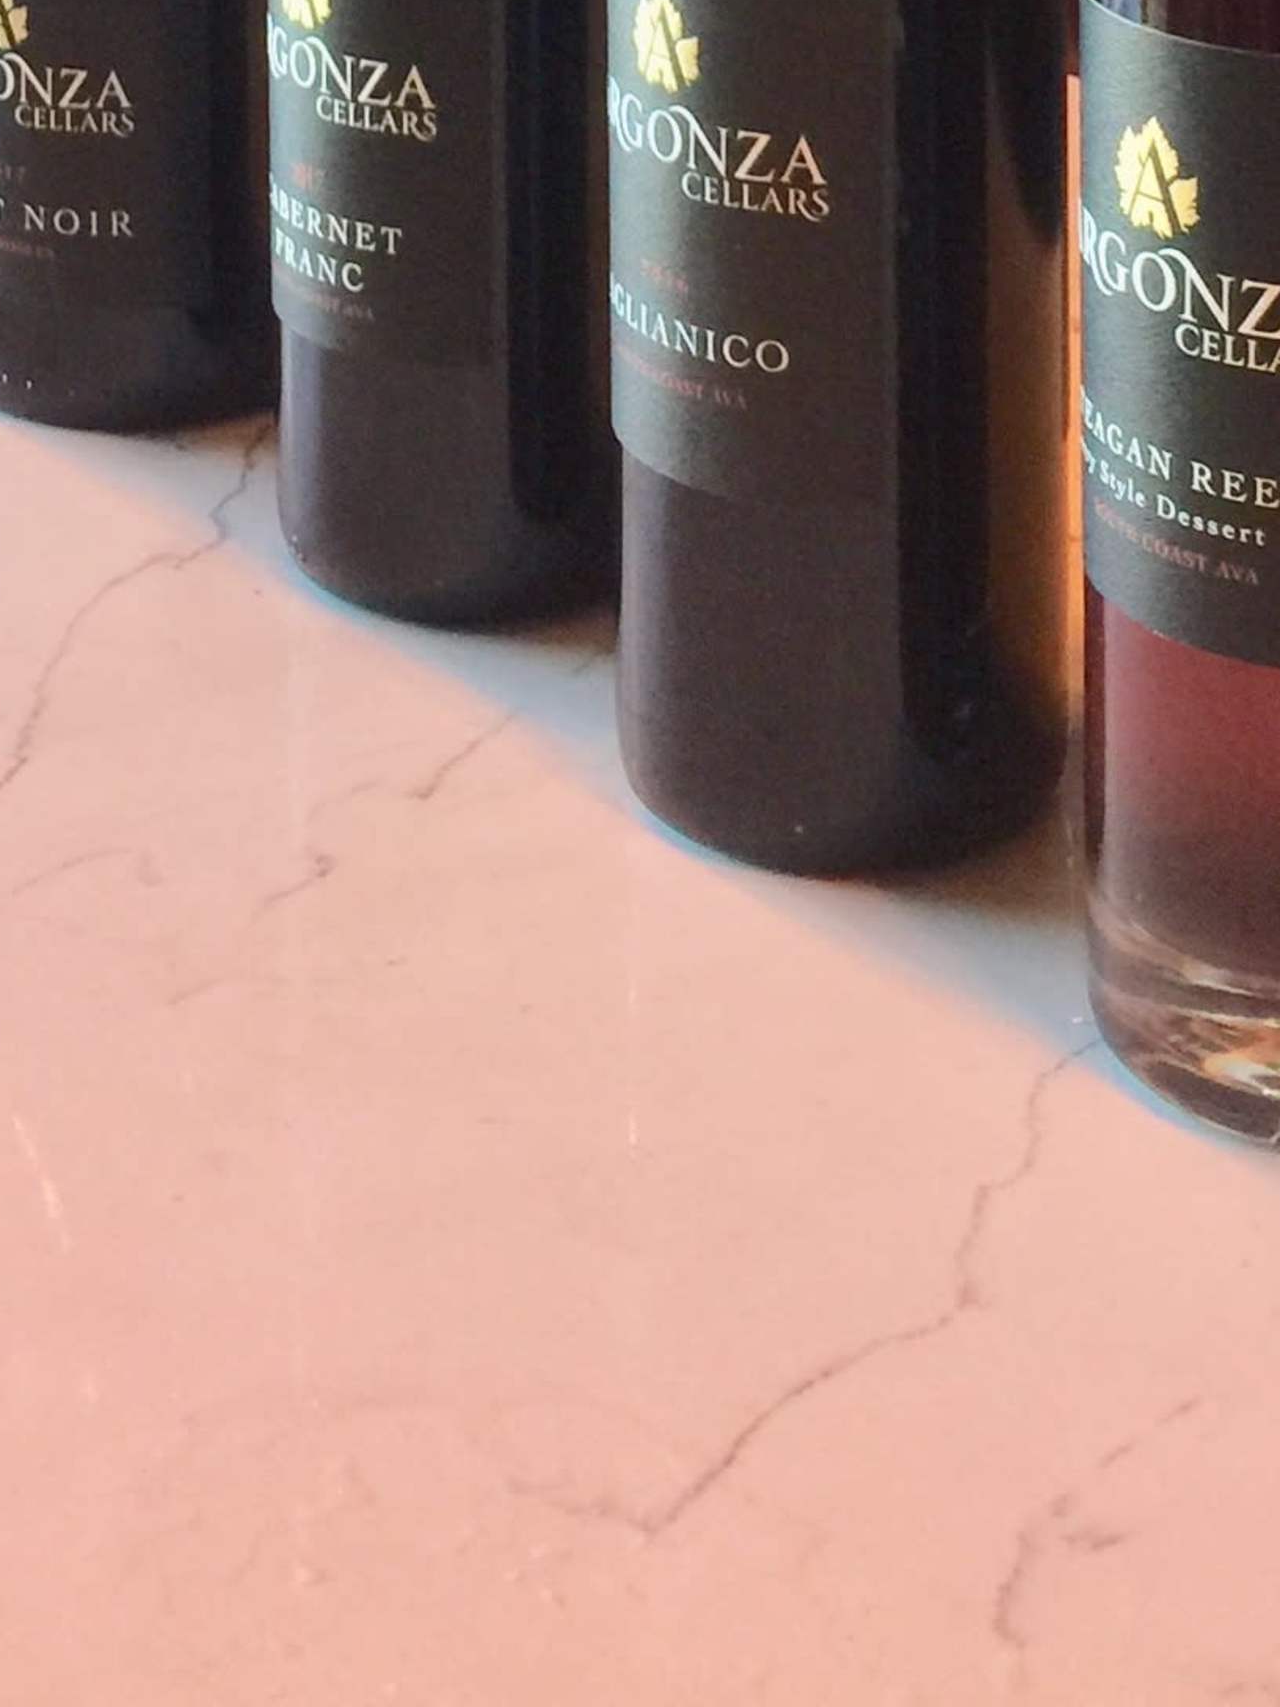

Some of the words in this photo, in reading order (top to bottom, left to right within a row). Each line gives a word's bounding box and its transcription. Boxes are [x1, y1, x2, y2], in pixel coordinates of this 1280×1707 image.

[14, 104, 135, 137] CELLARS
[316, 95, 438, 143] CELLARS
[608, 75, 828, 187] RGONZA
[23, 203, 132, 238] NOIR
[269, 170, 402, 255] ABERNET
[681, 171, 831, 223] CELLARS
[275, 228, 364, 293] FRANC
[609, 271, 790, 373] GLIANICO
[1080, 384, 1172, 481] EAGAN
[1100, 461, 1146, 508] Style
[1156, 493, 1266, 547] Dessert
